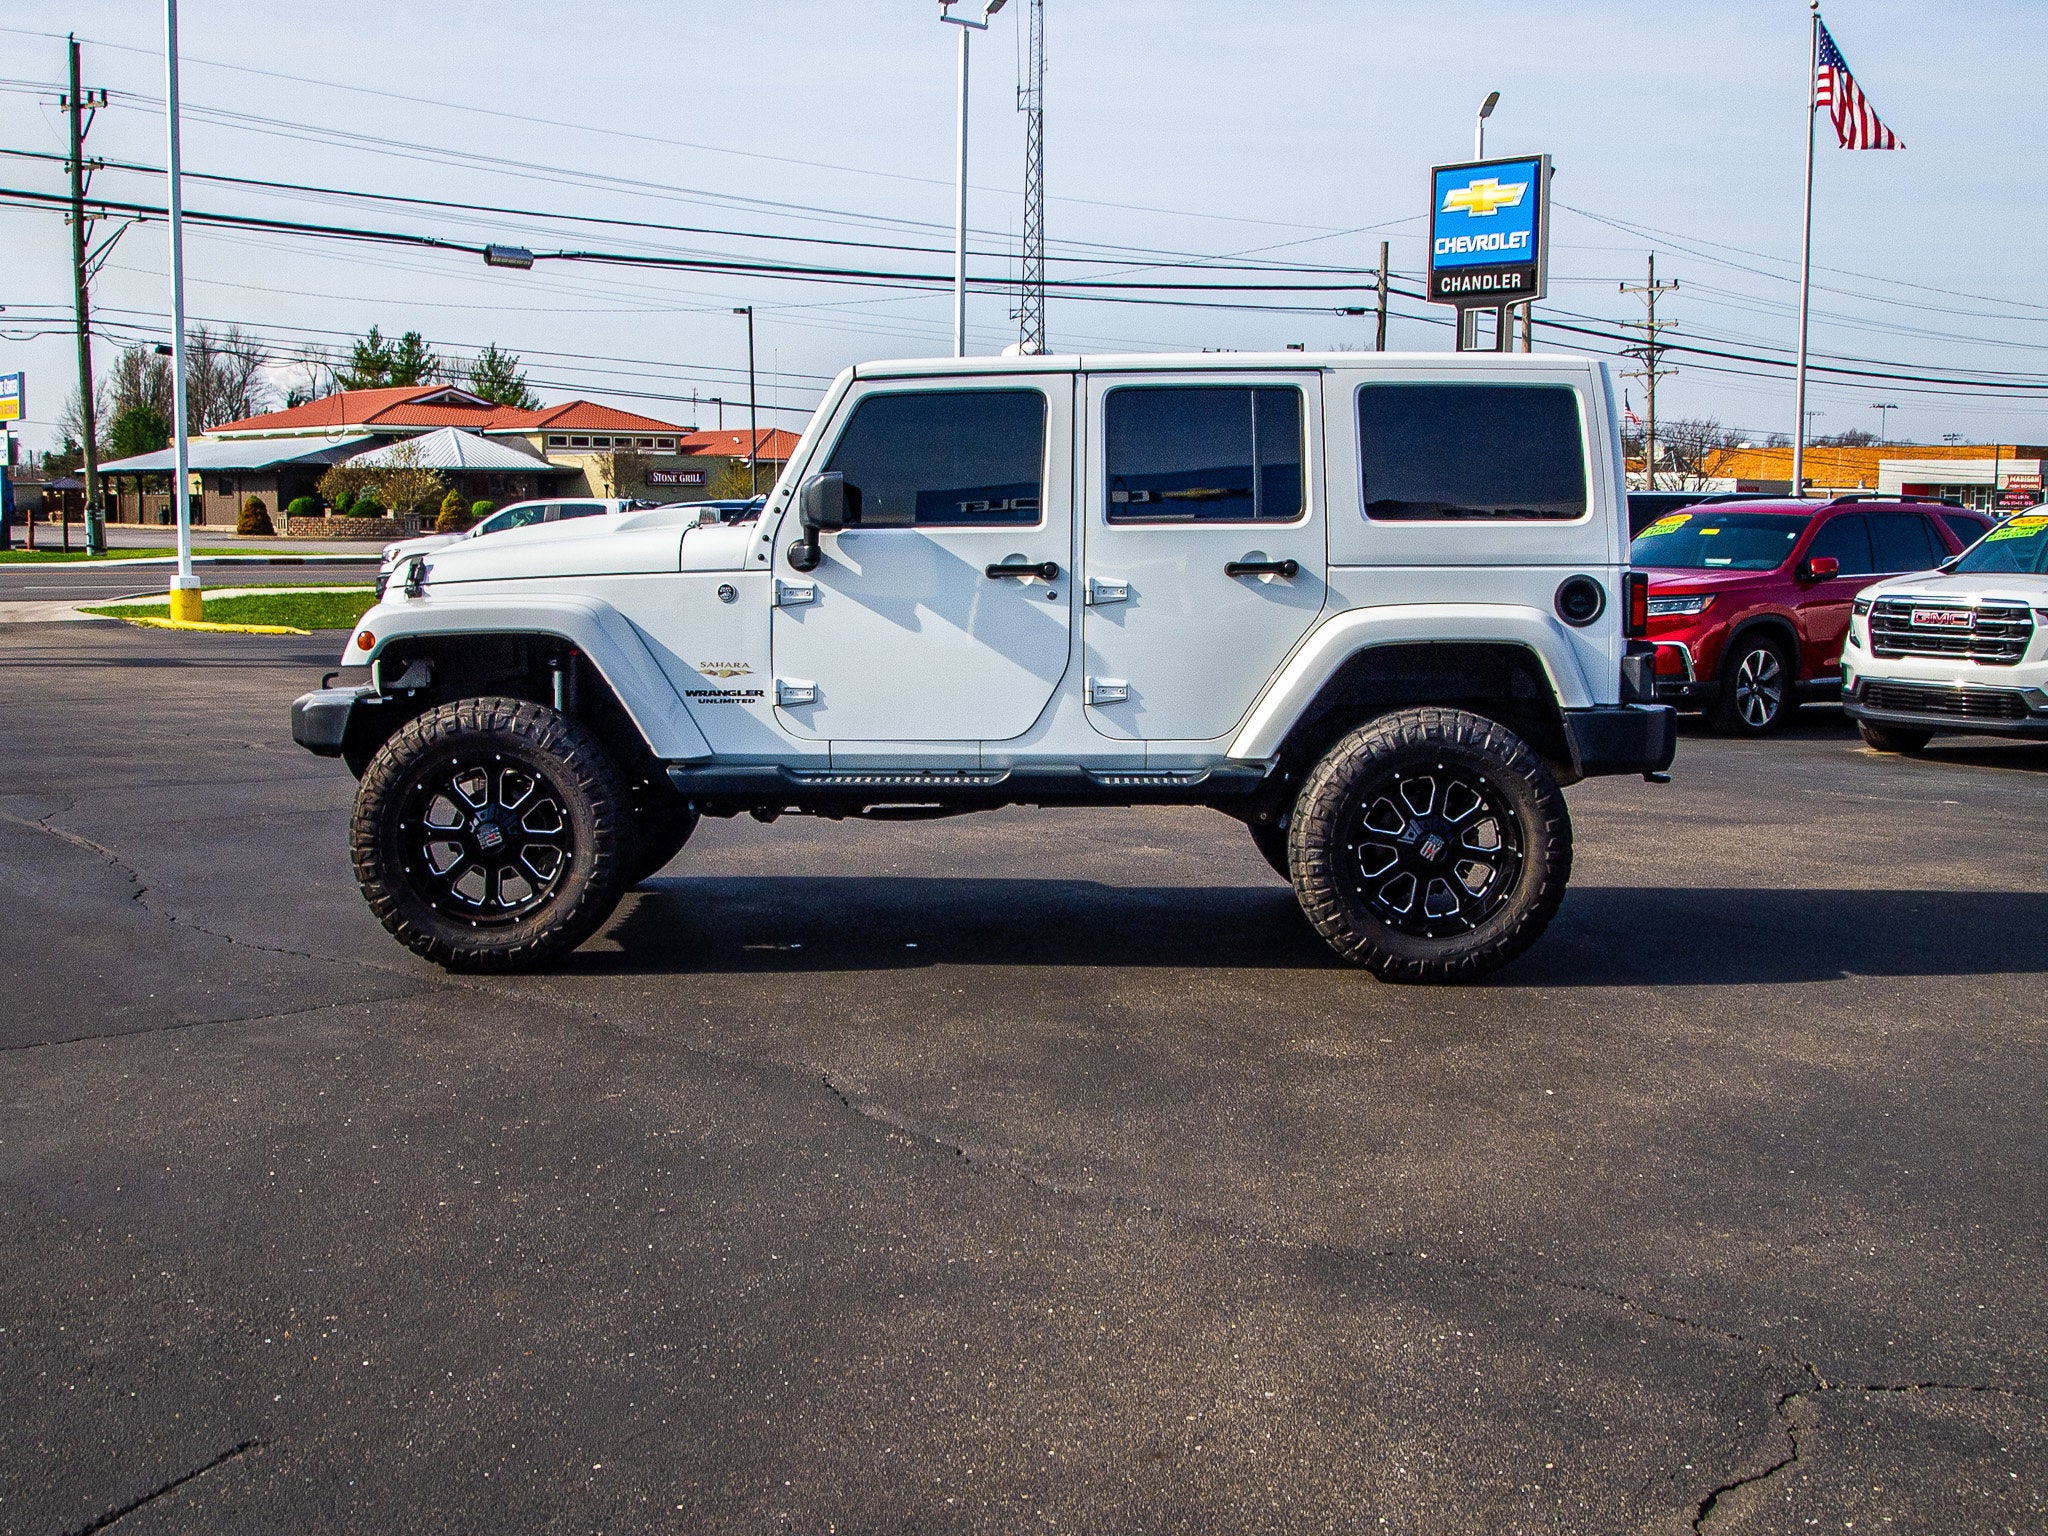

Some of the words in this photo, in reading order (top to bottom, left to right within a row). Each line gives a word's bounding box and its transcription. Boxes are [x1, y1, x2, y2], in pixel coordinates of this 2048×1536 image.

[1435, 231, 1530, 254] CHEVROLET
[1441, 273, 1521, 292] CHANDLER
[653, 472, 677, 482] STONE
[679, 474, 701, 482] GRILL
[2009, 475, 2039, 483] MADISON
[1914, 611, 1969, 626] GMC
